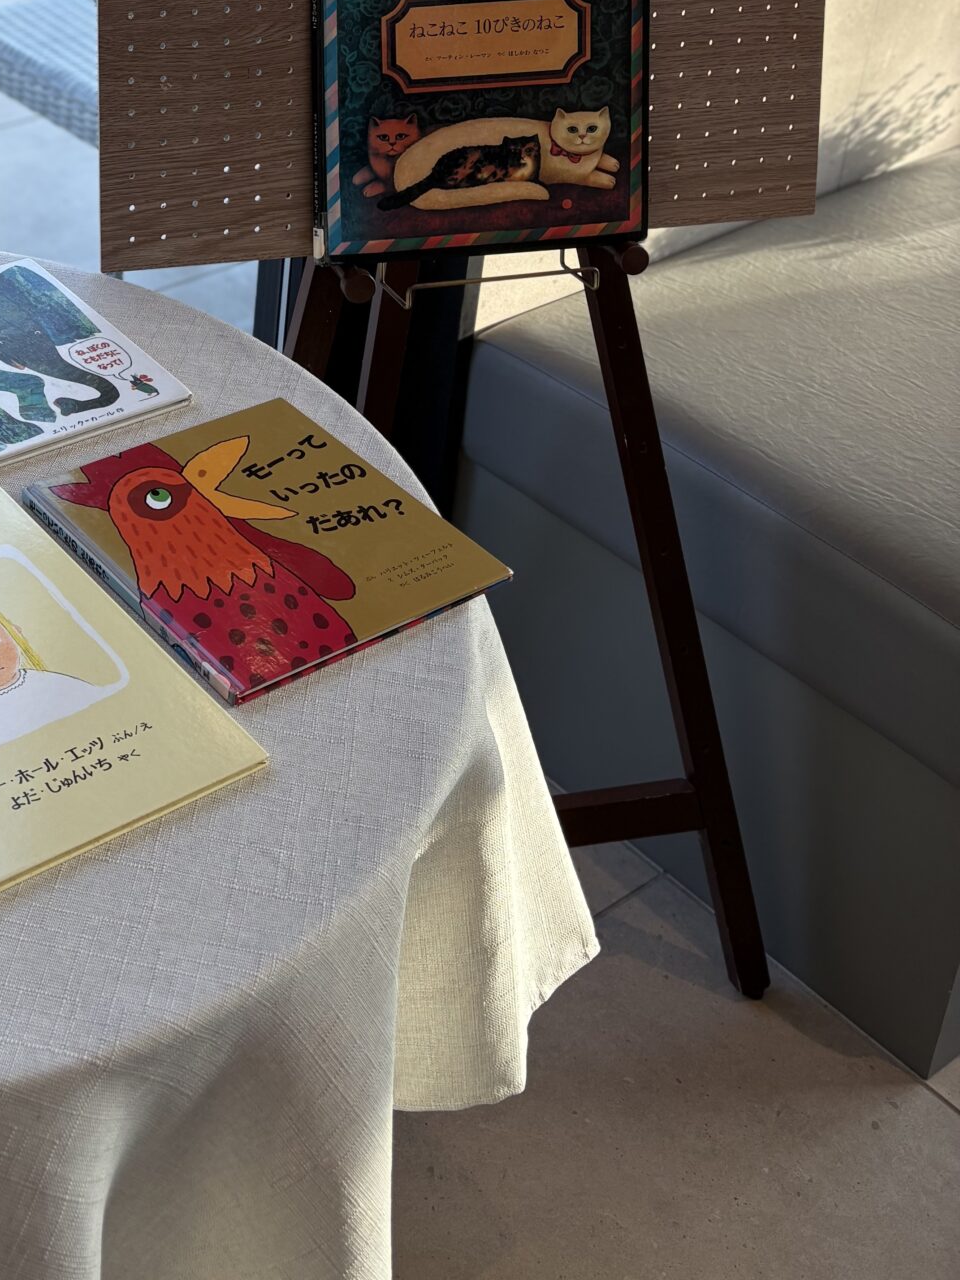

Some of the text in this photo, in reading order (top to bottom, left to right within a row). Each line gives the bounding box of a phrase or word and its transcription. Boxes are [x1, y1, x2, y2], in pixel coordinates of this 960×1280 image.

[409, 15, 565, 39] ねこねこ 10ぴきのねこ
[83, 349, 121, 364] ともだちに
[241, 434, 327, 480] モーって
[269, 463, 367, 502] いったの
[306, 498, 405, 535] だあれ？
[11, 749, 141, 810] よだ・じゅんいち やく
